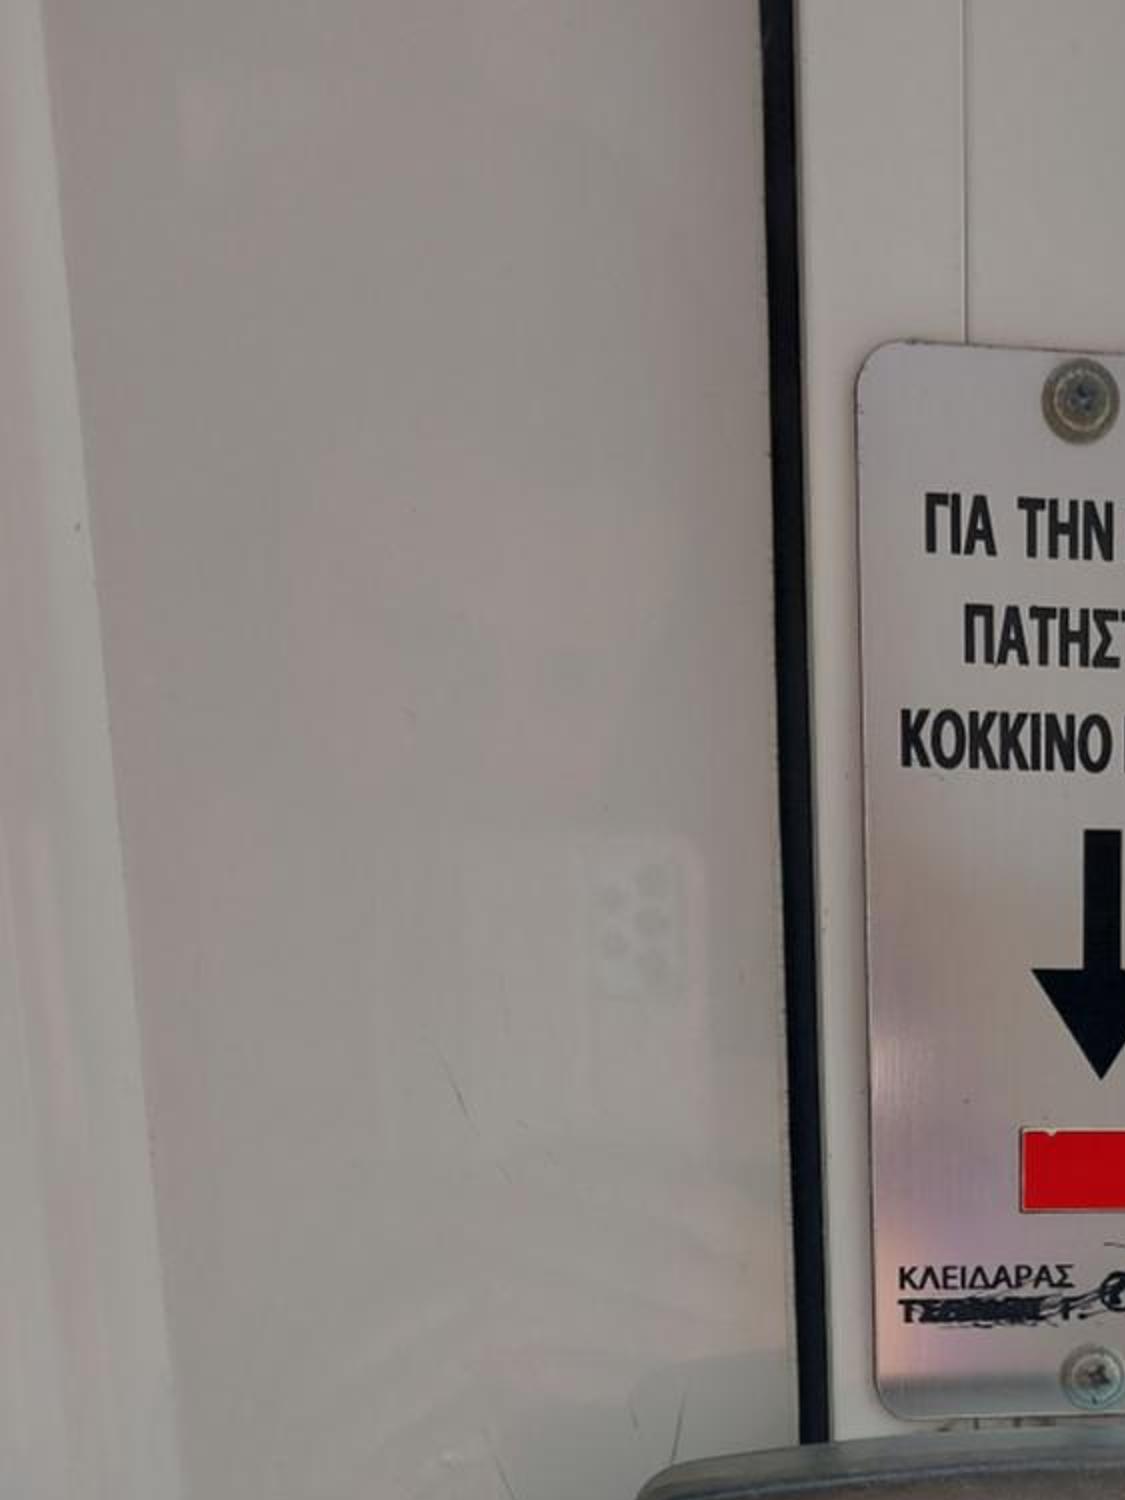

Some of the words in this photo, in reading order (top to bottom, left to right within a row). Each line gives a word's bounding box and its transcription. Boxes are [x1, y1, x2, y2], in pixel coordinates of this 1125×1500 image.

[925, 492, 997, 557] ΓΙΑ
[1017, 496, 1114, 562] ΤΗΝ
[900, 708, 1112, 774] ΚΟΚΚΙΝΟ
[899, 1264, 1075, 1290] ΚΛΕΙΔΑΡΑΣ
